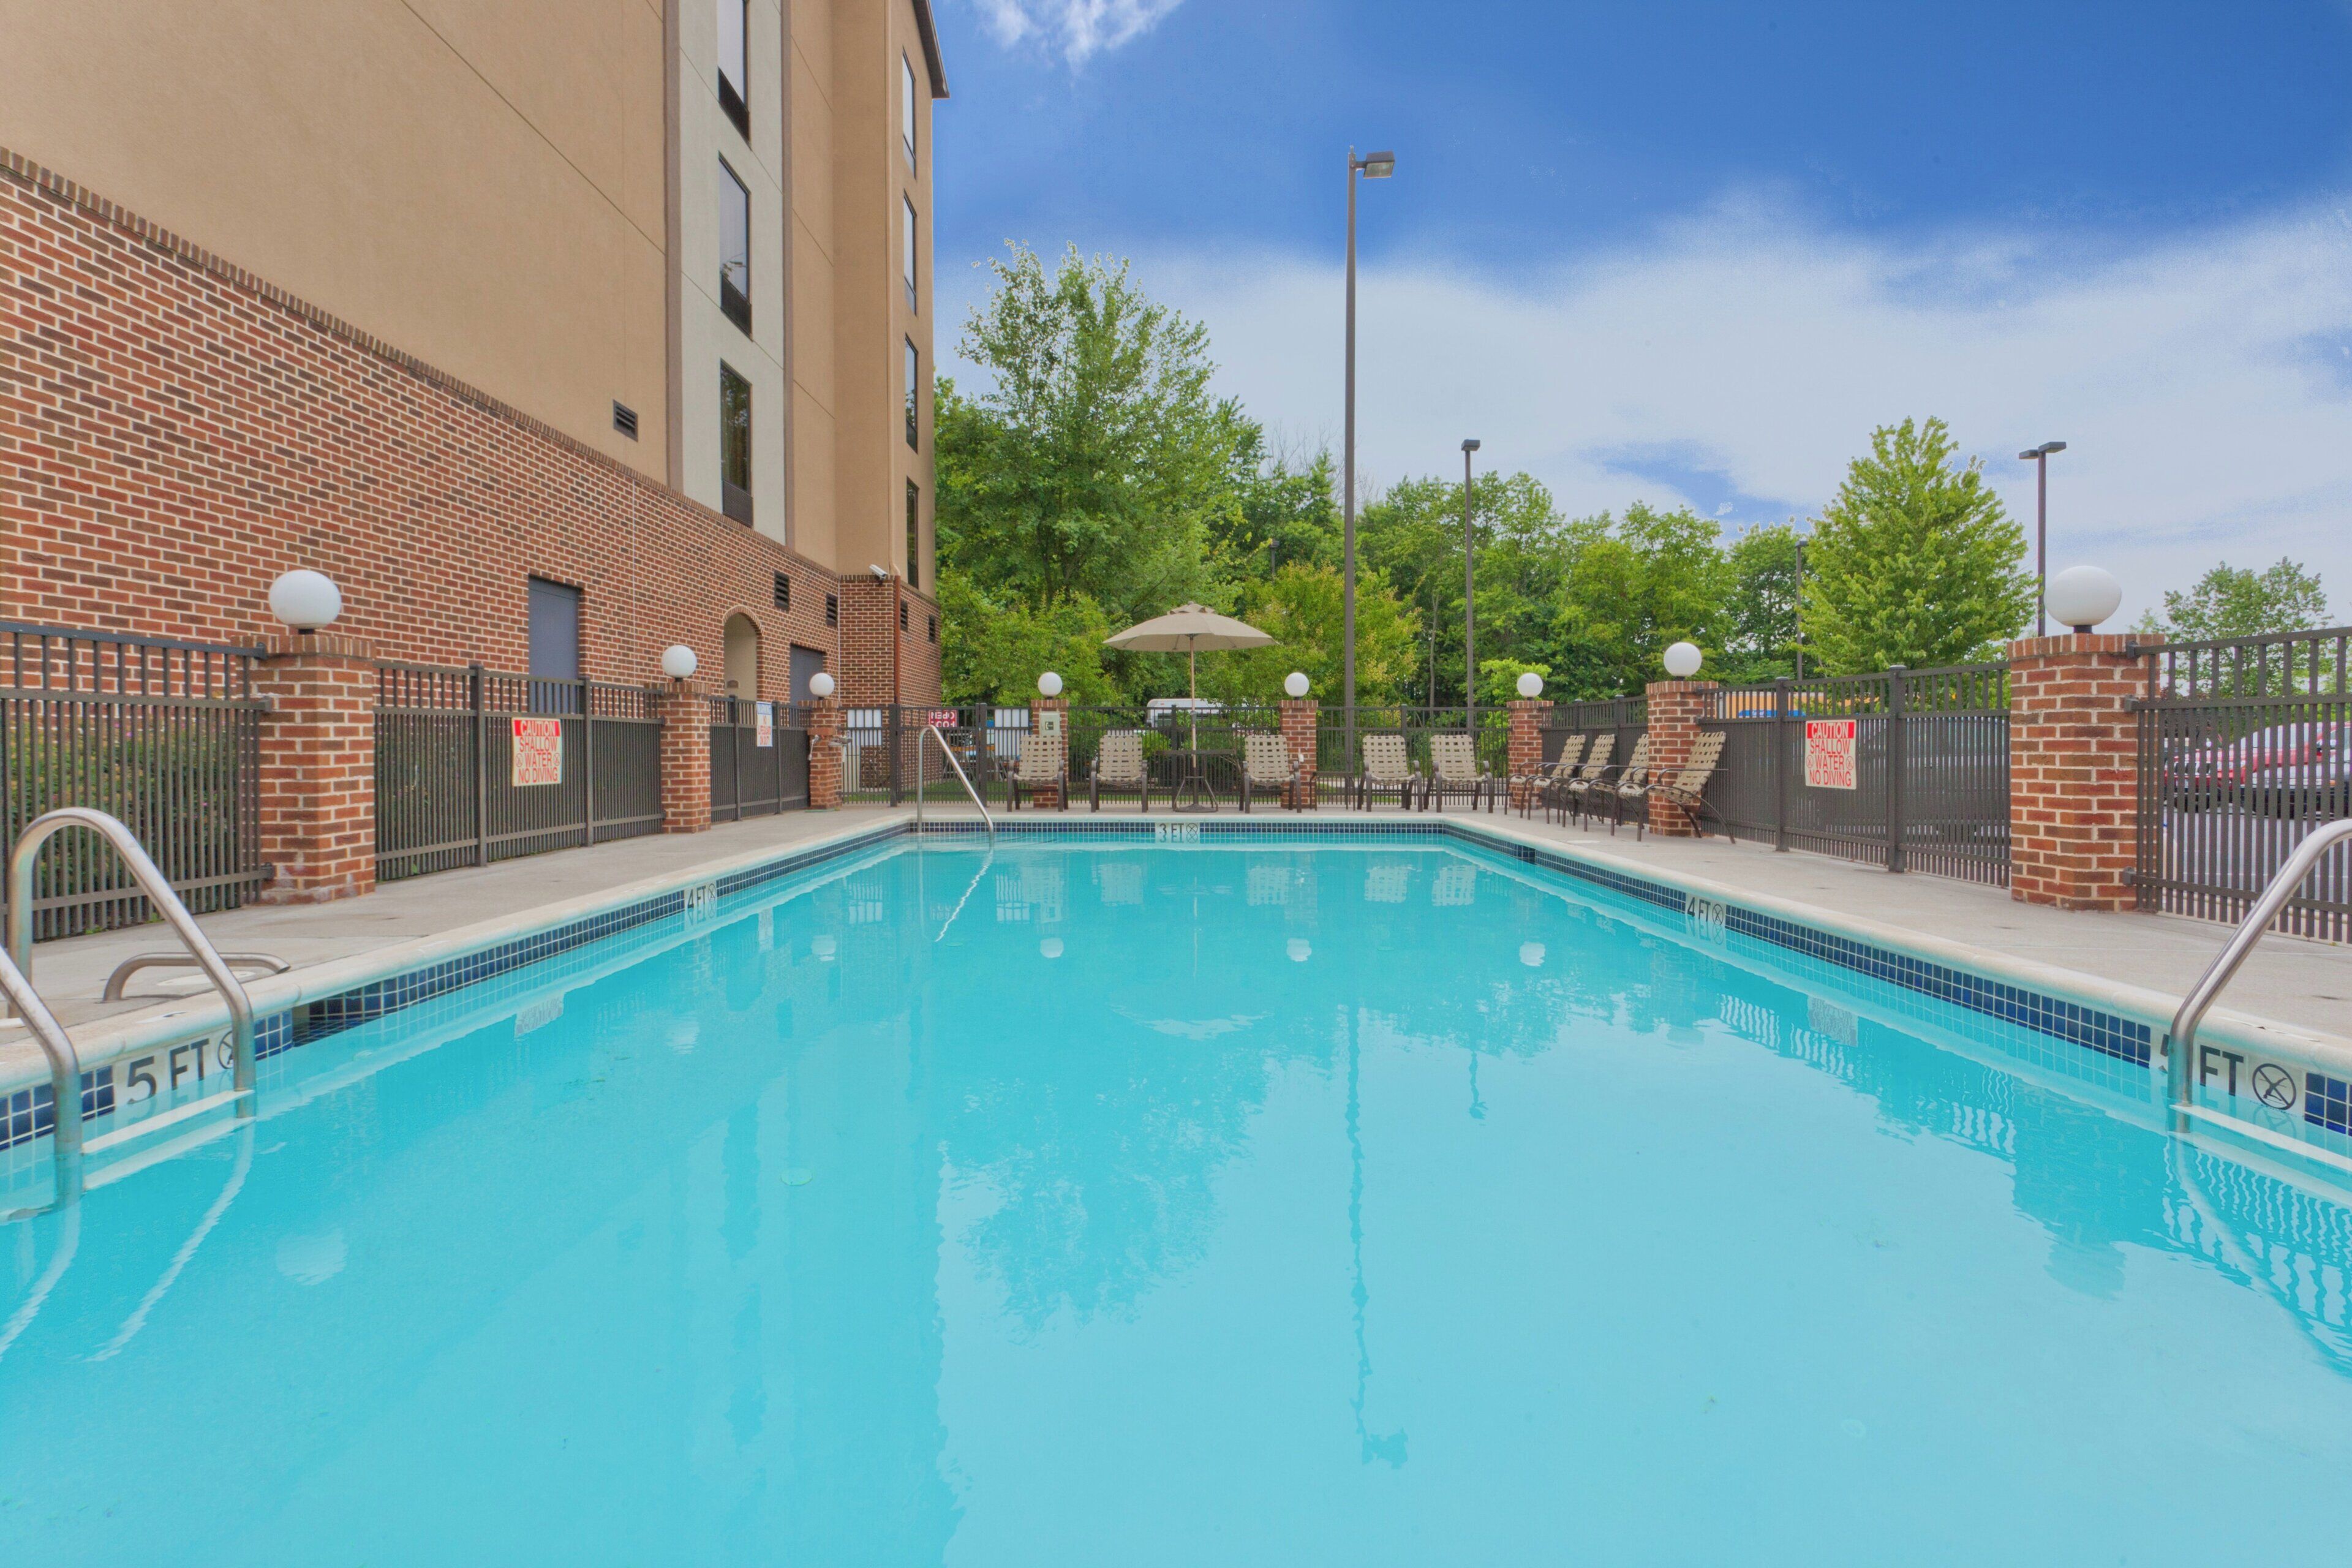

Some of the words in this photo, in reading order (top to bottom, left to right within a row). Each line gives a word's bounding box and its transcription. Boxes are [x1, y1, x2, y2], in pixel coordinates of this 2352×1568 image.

[521, 721, 556, 736] CAUTION
[1811, 722, 1849, 738] CAUTION
[519, 737, 557, 752] SHALLOW
[1810, 739, 1850, 754] SHALLOW
[524, 752, 552, 767] WATER
[1815, 755, 1844, 770] WATER
[519, 768, 530, 783] NO
[533, 767, 558, 782] DIVING
[1809, 769, 1821, 785] NO
[1823, 770, 1851, 786] DIVING
[1159, 823, 1167, 834] 3
[1171, 823, 1184, 834] FT
[687, 889, 694, 908] 4
[696, 886, 706, 907] FT
[1687, 897, 1695, 917] 4
[1698, 899, 1711, 922] FT
[127, 1055, 157, 1105] 5
[169, 1038, 209, 1091] FT
[2199, 1044, 2244, 1096] FT
